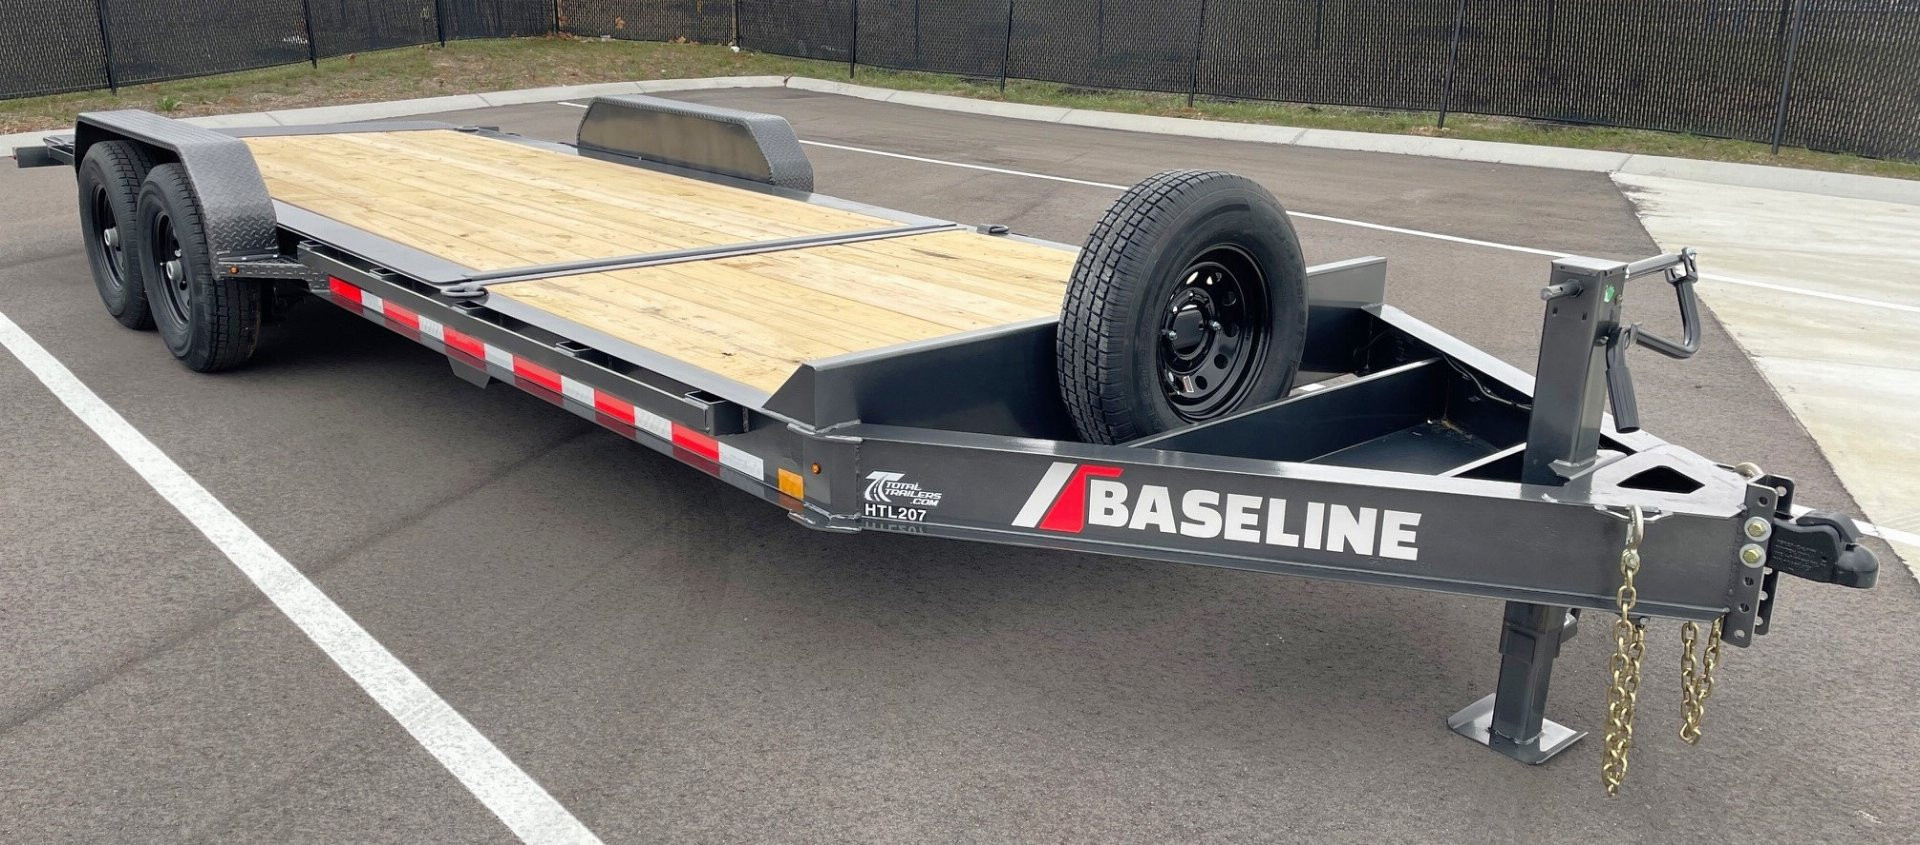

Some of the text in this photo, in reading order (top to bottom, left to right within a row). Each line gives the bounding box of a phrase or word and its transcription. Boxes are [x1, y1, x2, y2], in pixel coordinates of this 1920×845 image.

[886, 482, 921, 490] TOTAL
[885, 489, 942, 499] TRAILERS
[865, 504, 926, 521] HTL207
[1088, 479, 1422, 561] BASELINE
